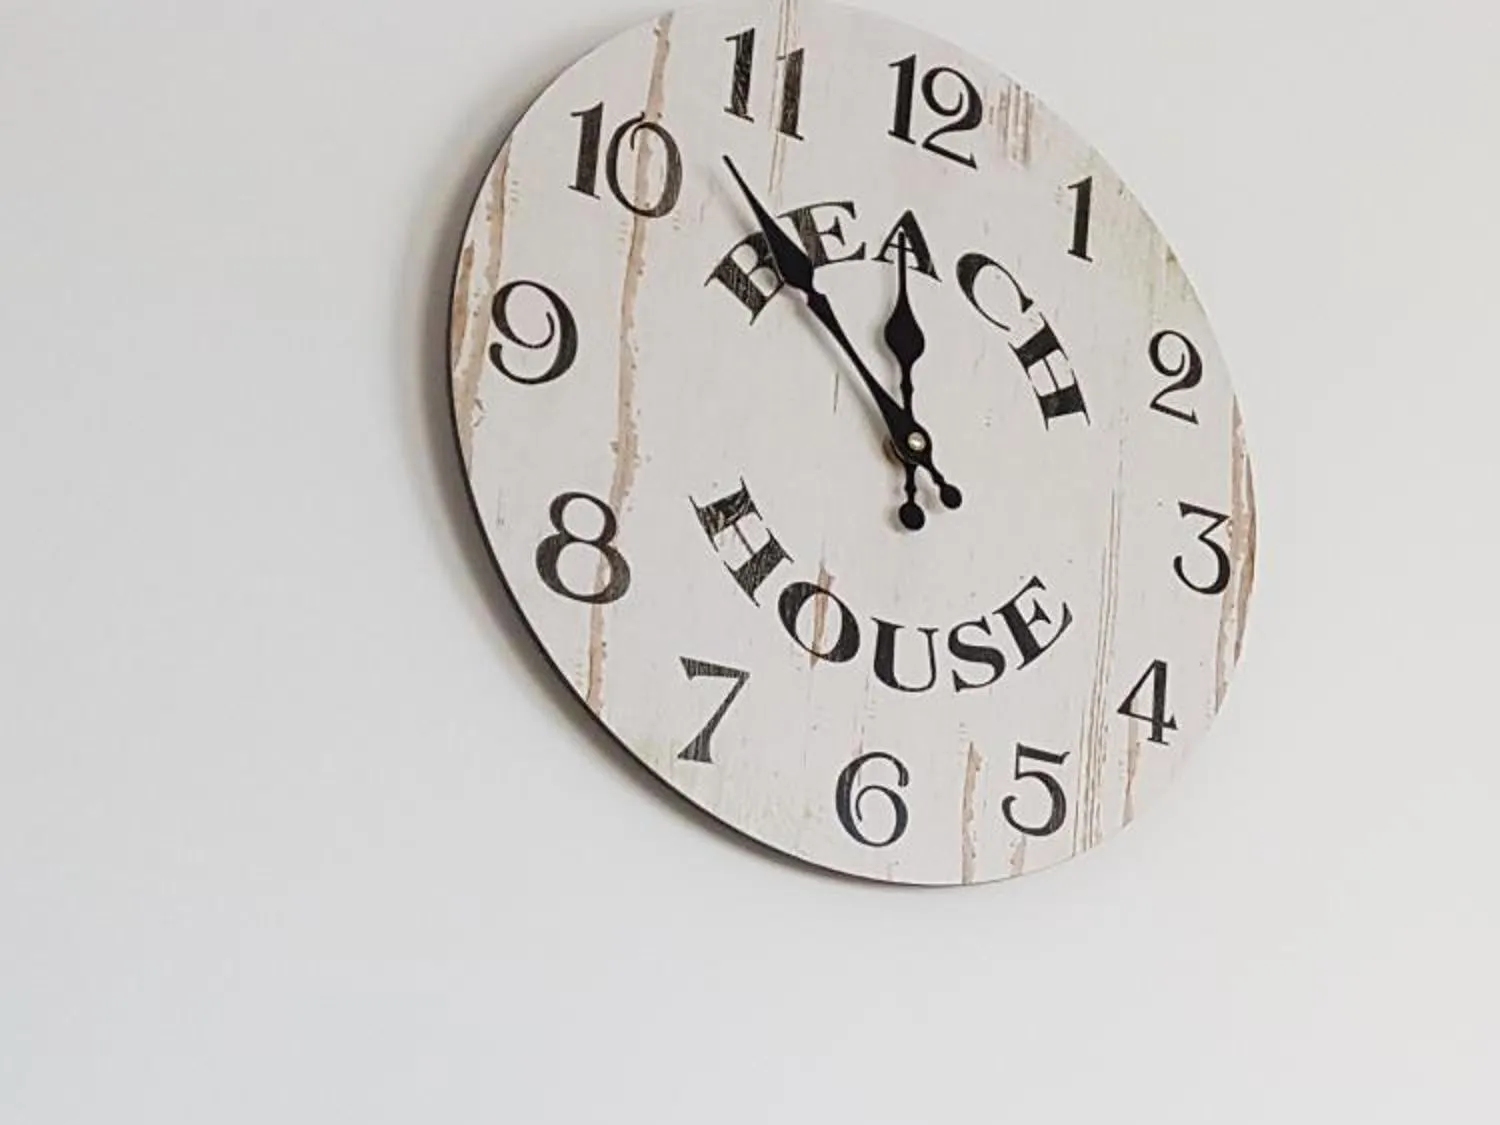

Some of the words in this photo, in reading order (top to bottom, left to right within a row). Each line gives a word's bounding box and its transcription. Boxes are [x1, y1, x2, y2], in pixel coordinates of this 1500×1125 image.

[724, 27, 806, 141] 11
[887, 53, 984, 170] 12
[569, 101, 683, 218] 10
[1066, 176, 1095, 262] 1
[489, 279, 579, 385] 9
[704, 200, 1091, 430] BEACH
[1147, 330, 1204, 425] 2
[535, 492, 631, 605] 8
[688, 477, 1074, 693] HOUSE
[1172, 501, 1231, 595] 3
[676, 655, 750, 764] 7
[1117, 659, 1179, 746] 4
[835, 751, 909, 847] 6
[1001, 743, 1070, 838] 5
